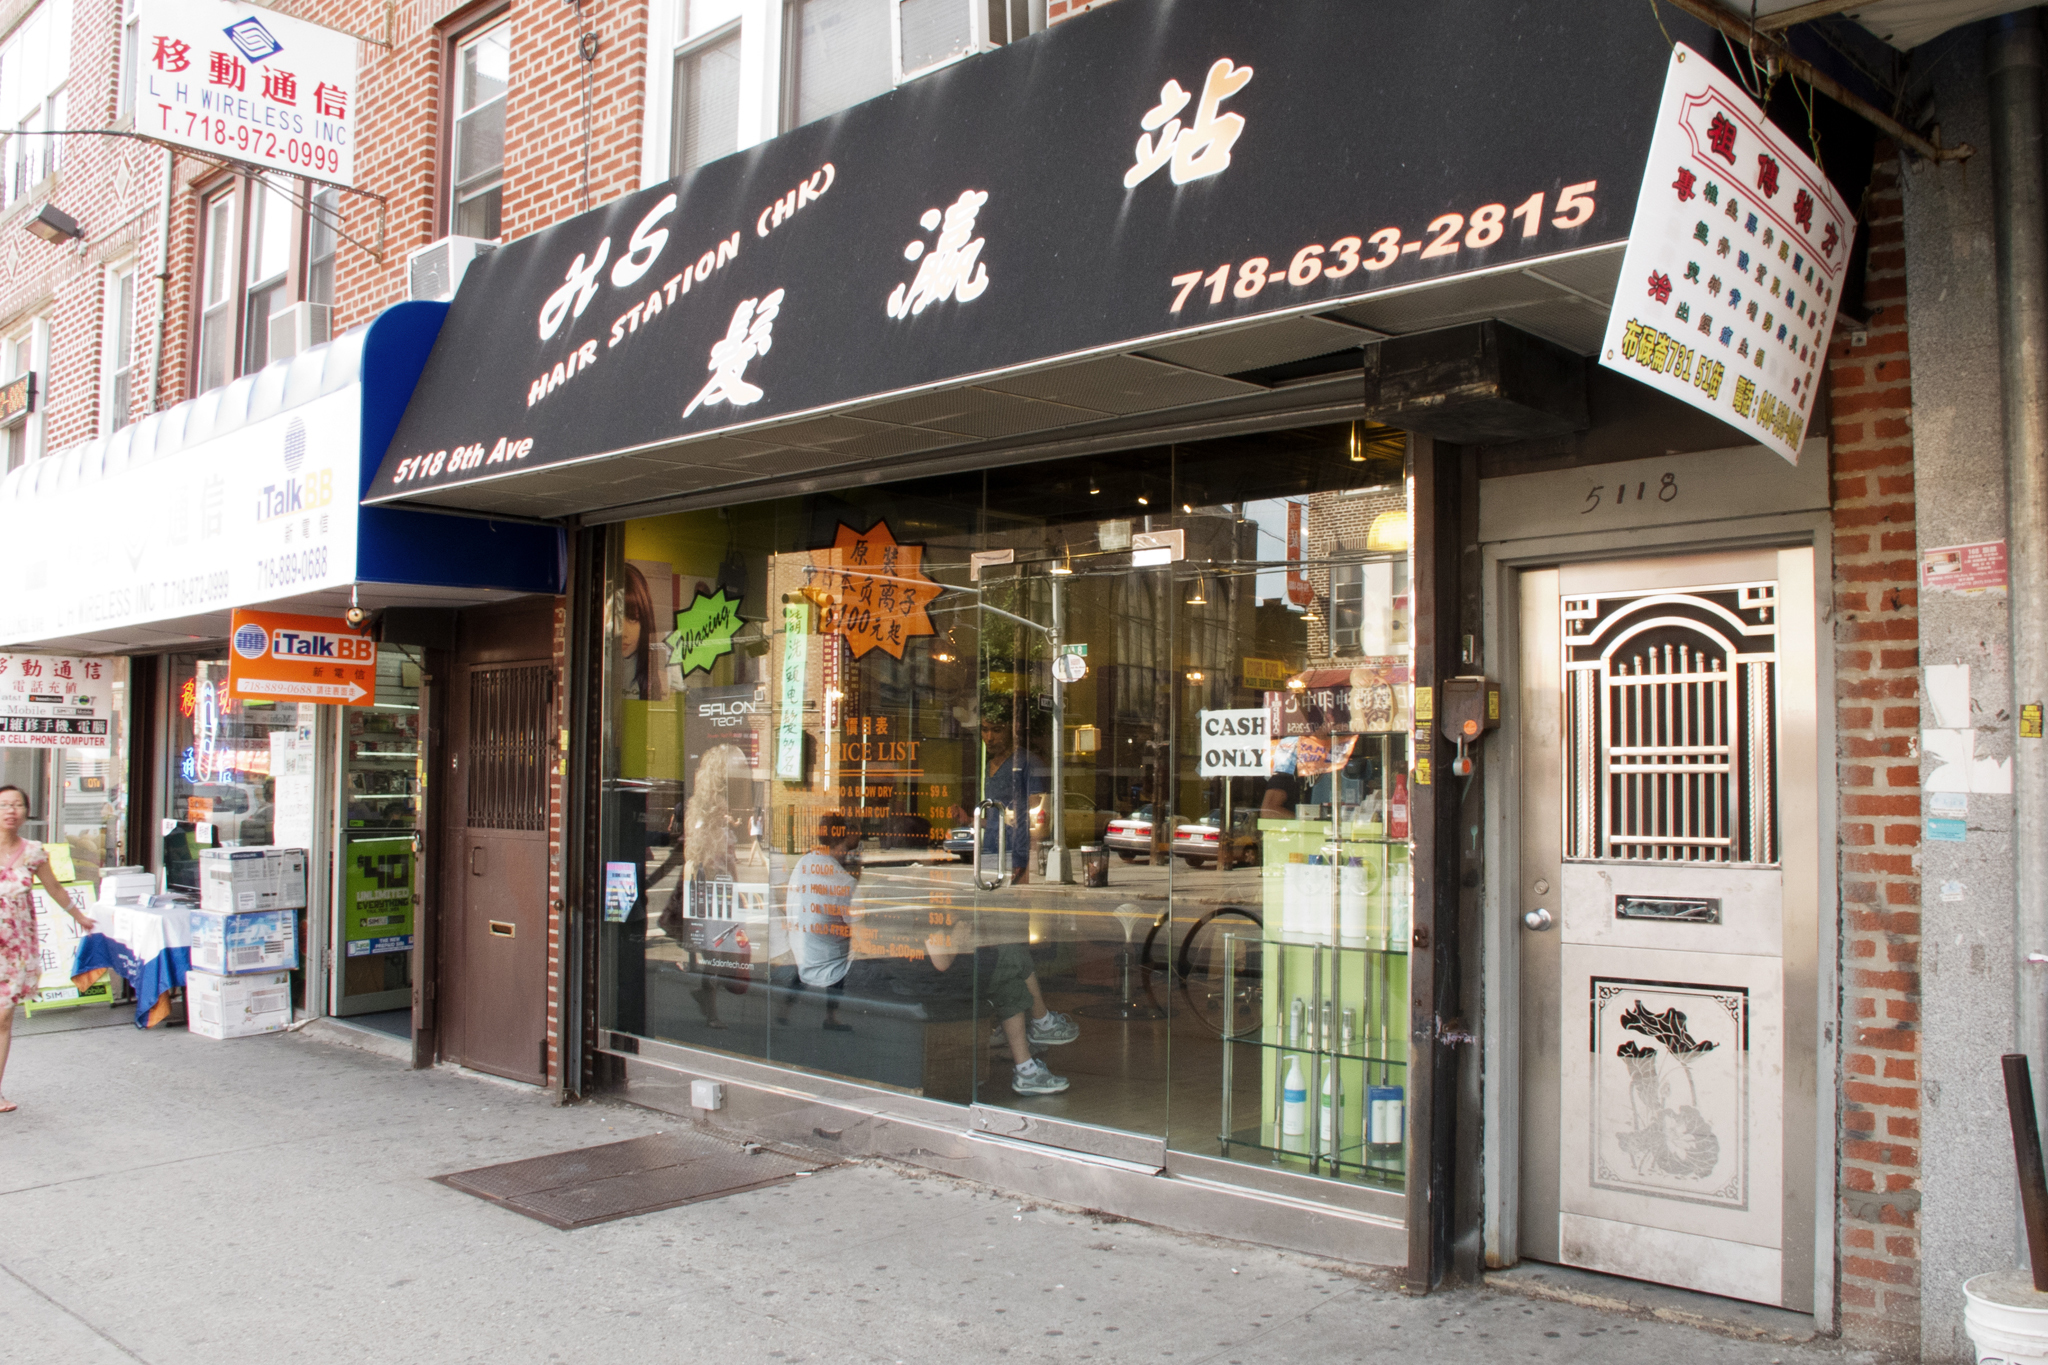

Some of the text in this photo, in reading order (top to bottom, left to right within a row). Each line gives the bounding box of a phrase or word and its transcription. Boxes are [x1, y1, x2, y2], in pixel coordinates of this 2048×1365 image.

[152, 36, 348, 119] 移動通信
[150, 75, 347, 145] L H WIRELESS INC
[158, 105, 339, 173] T.718-972-0999
[1707, 112, 1840, 259] 祖傳秘方
[1169, 180, 1597, 314] 718-633-2815
[527, 162, 835, 407] HAIR STATION (HK)
[393, 437, 534, 483] 5118 8th Ave
[256, 467, 333, 521] iTalkBB
[1581, 472, 1678, 514] 5118
[257, 545, 328, 590] 718-889-0688
[135, 582, 156, 614] INC
[676, 605, 730, 660] Waxing
[274, 632, 372, 661] iTalkBB
[313, 667, 366, 680] 新電信
[243, 681, 312, 694] 718-889-0688
[699, 701, 756, 716] SALON
[846, 717, 888, 735] 價目表
[1205, 717, 1266, 736] CASH
[8, 735, 27, 744] CELL
[31, 735, 57, 744] PHONE
[60, 736, 105, 746] COMPUTER
[820, 742, 920, 761] PRICE LIST
[1205, 749, 1264, 768] ONLY
[878, 786, 893, 797] DRY
[874, 807, 890, 818] CUT
[831, 826, 846, 837] CUT
[811, 864, 834, 875] COLOR
[356, 889, 409, 902] UNLIMITED
[829, 885, 850, 896] LIGHT
[357, 898, 409, 910] EVERYTHING
